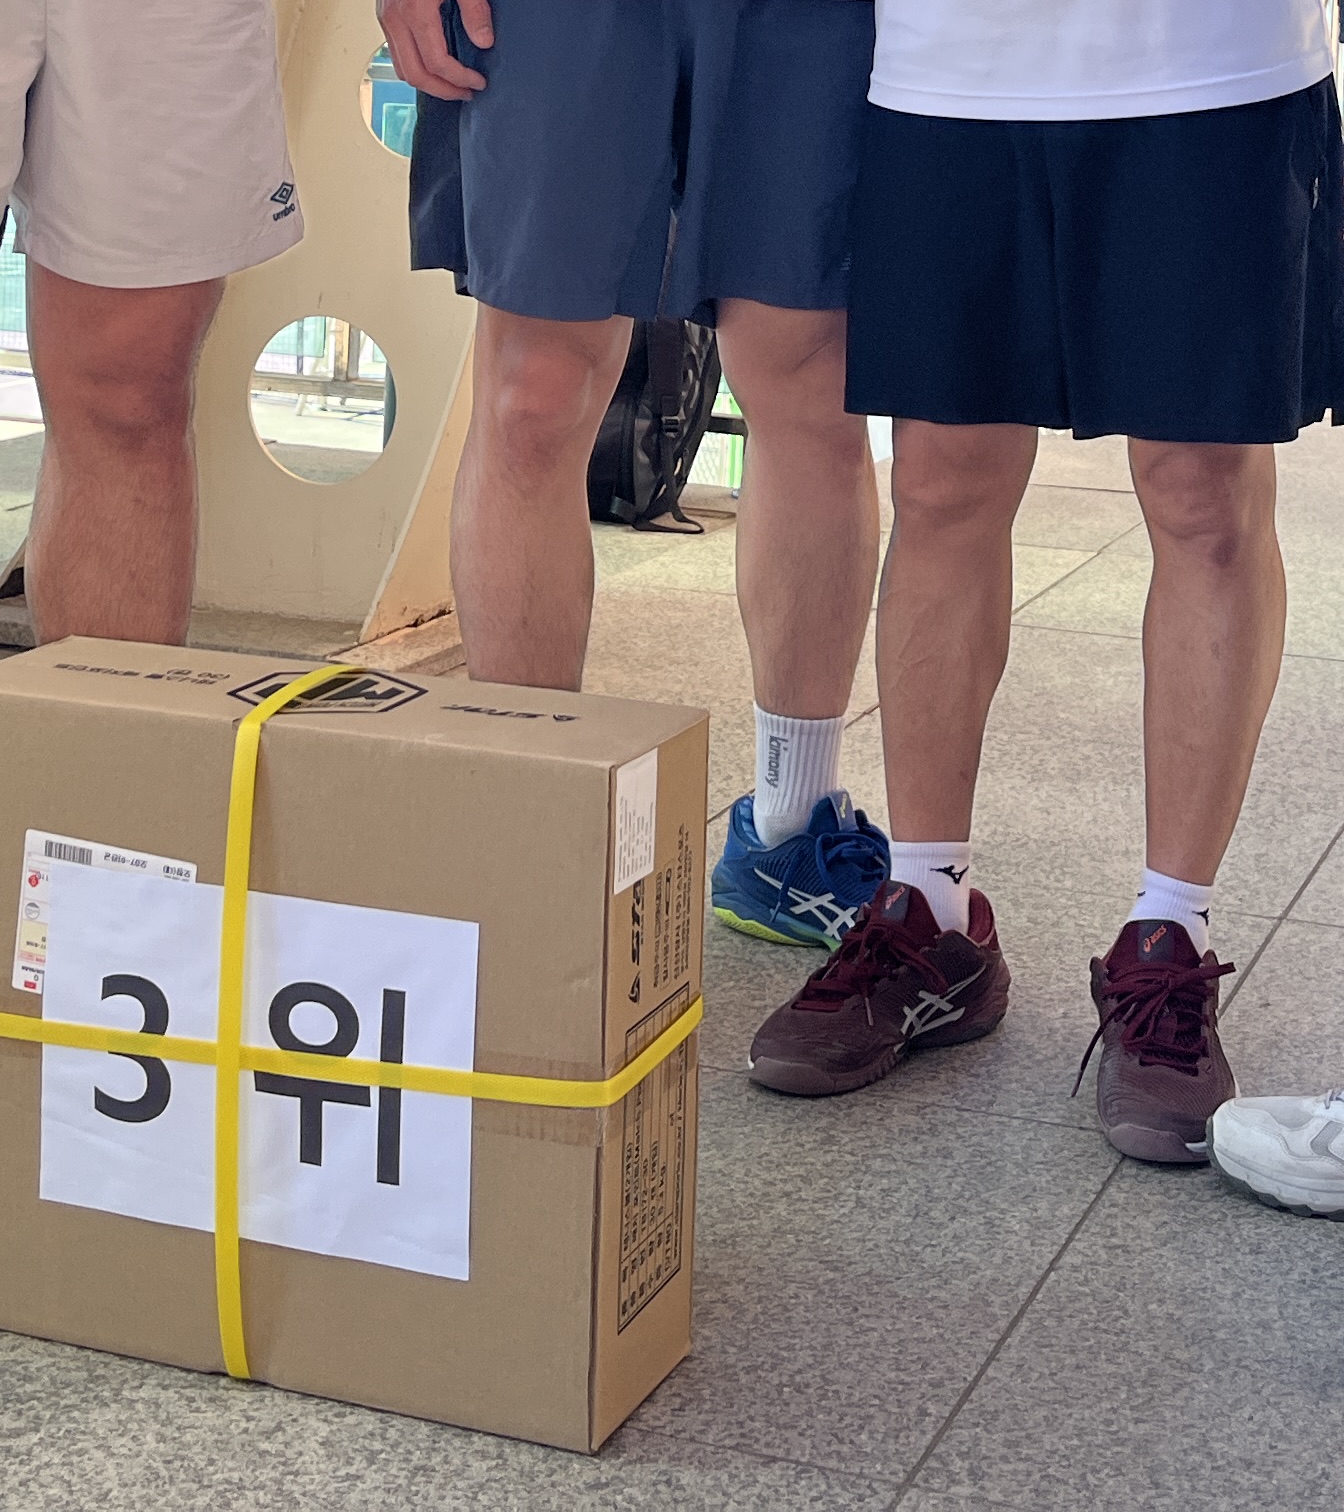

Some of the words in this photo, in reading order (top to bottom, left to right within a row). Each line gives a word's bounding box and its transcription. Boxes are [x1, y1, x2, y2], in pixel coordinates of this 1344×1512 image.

[272, 203, 295, 221] umbro
[765, 735, 788, 788] kimony
[254, 982, 407, 1186] 위
